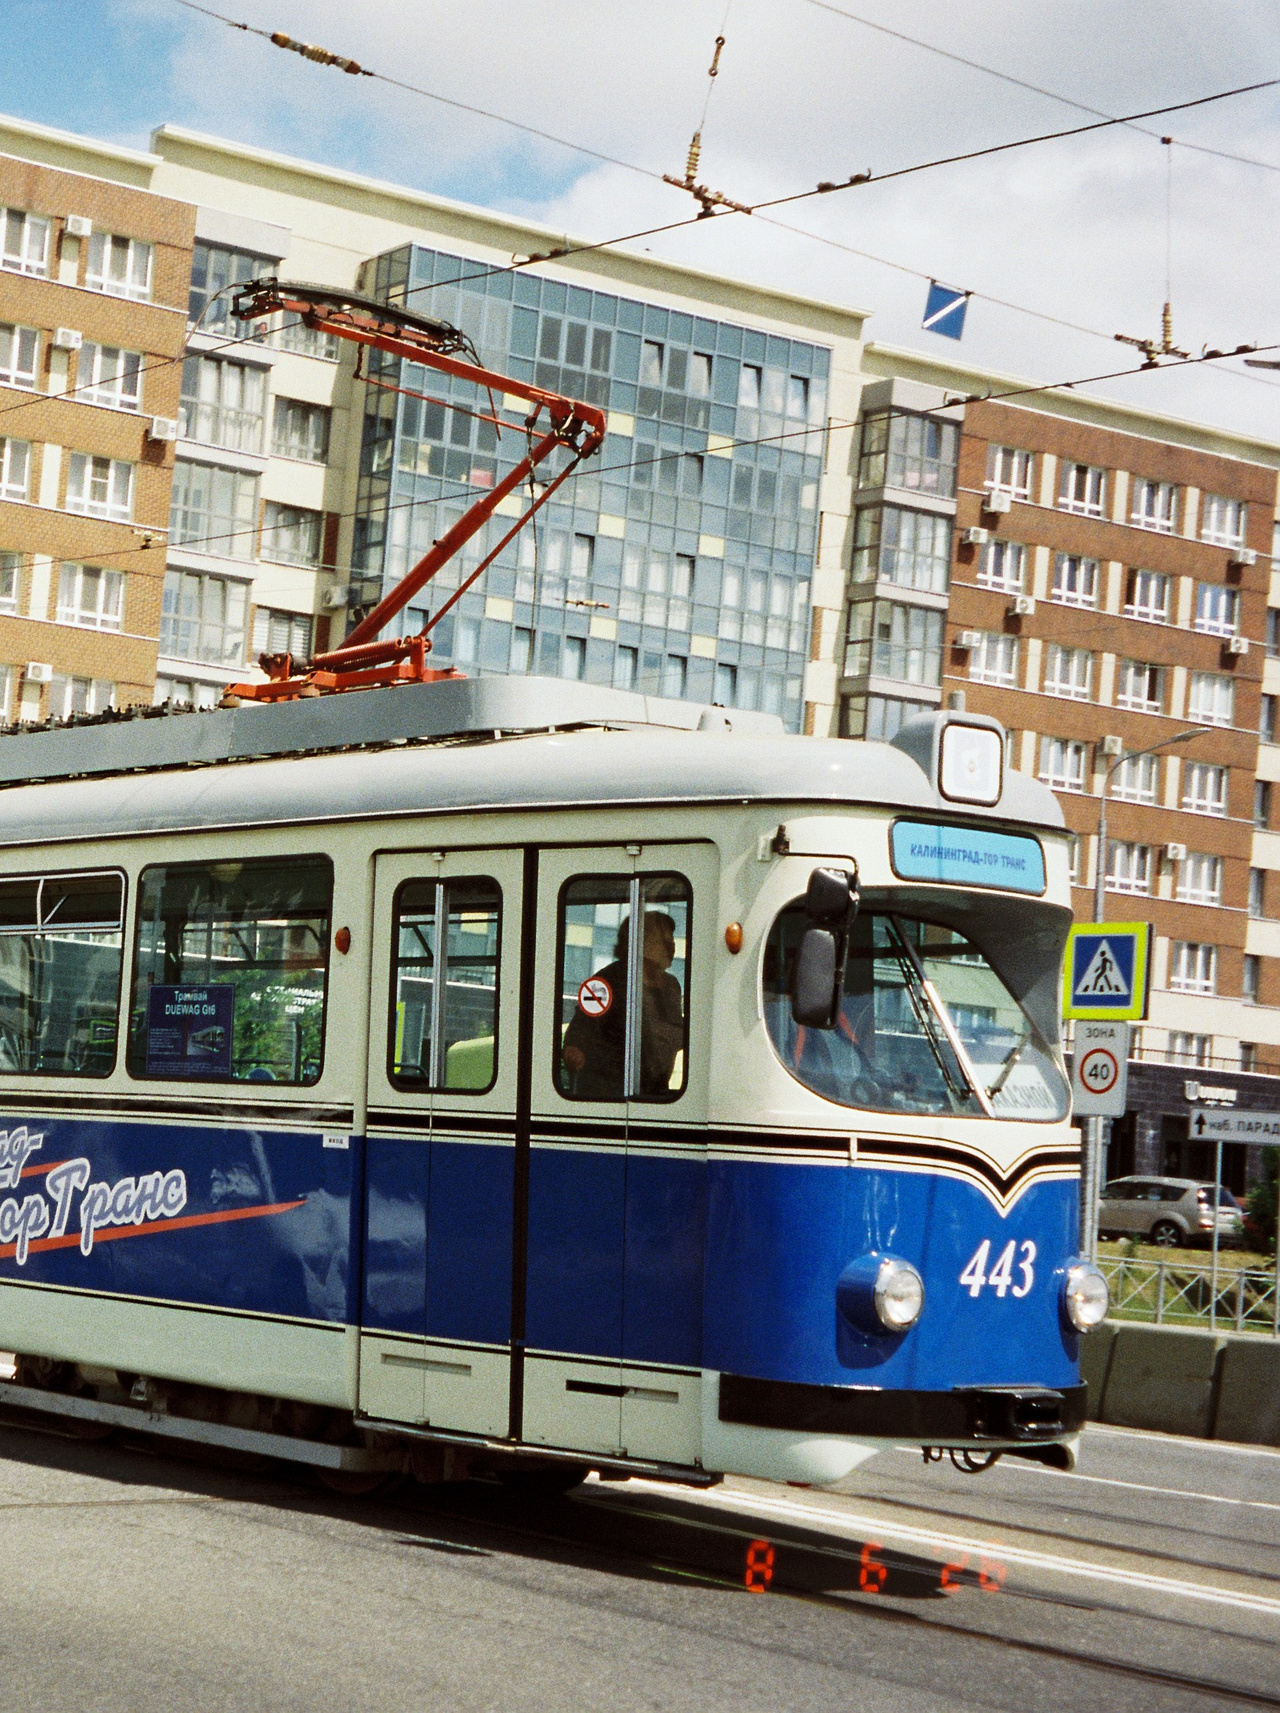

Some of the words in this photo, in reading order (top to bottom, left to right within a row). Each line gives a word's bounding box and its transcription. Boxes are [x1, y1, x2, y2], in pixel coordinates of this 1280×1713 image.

[1001, 855, 1026, 871] ТРАНС
[173, 990, 208, 1003] Трамвай
[165, 1004, 201, 1016] DUEWAG
[1085, 1027, 1116, 1039] ЗОНА
[1088, 1063, 1110, 1081] 40
[990, 1082, 1056, 1109] АКАЗНОЙ
[959, 1239, 1038, 1298] 443
